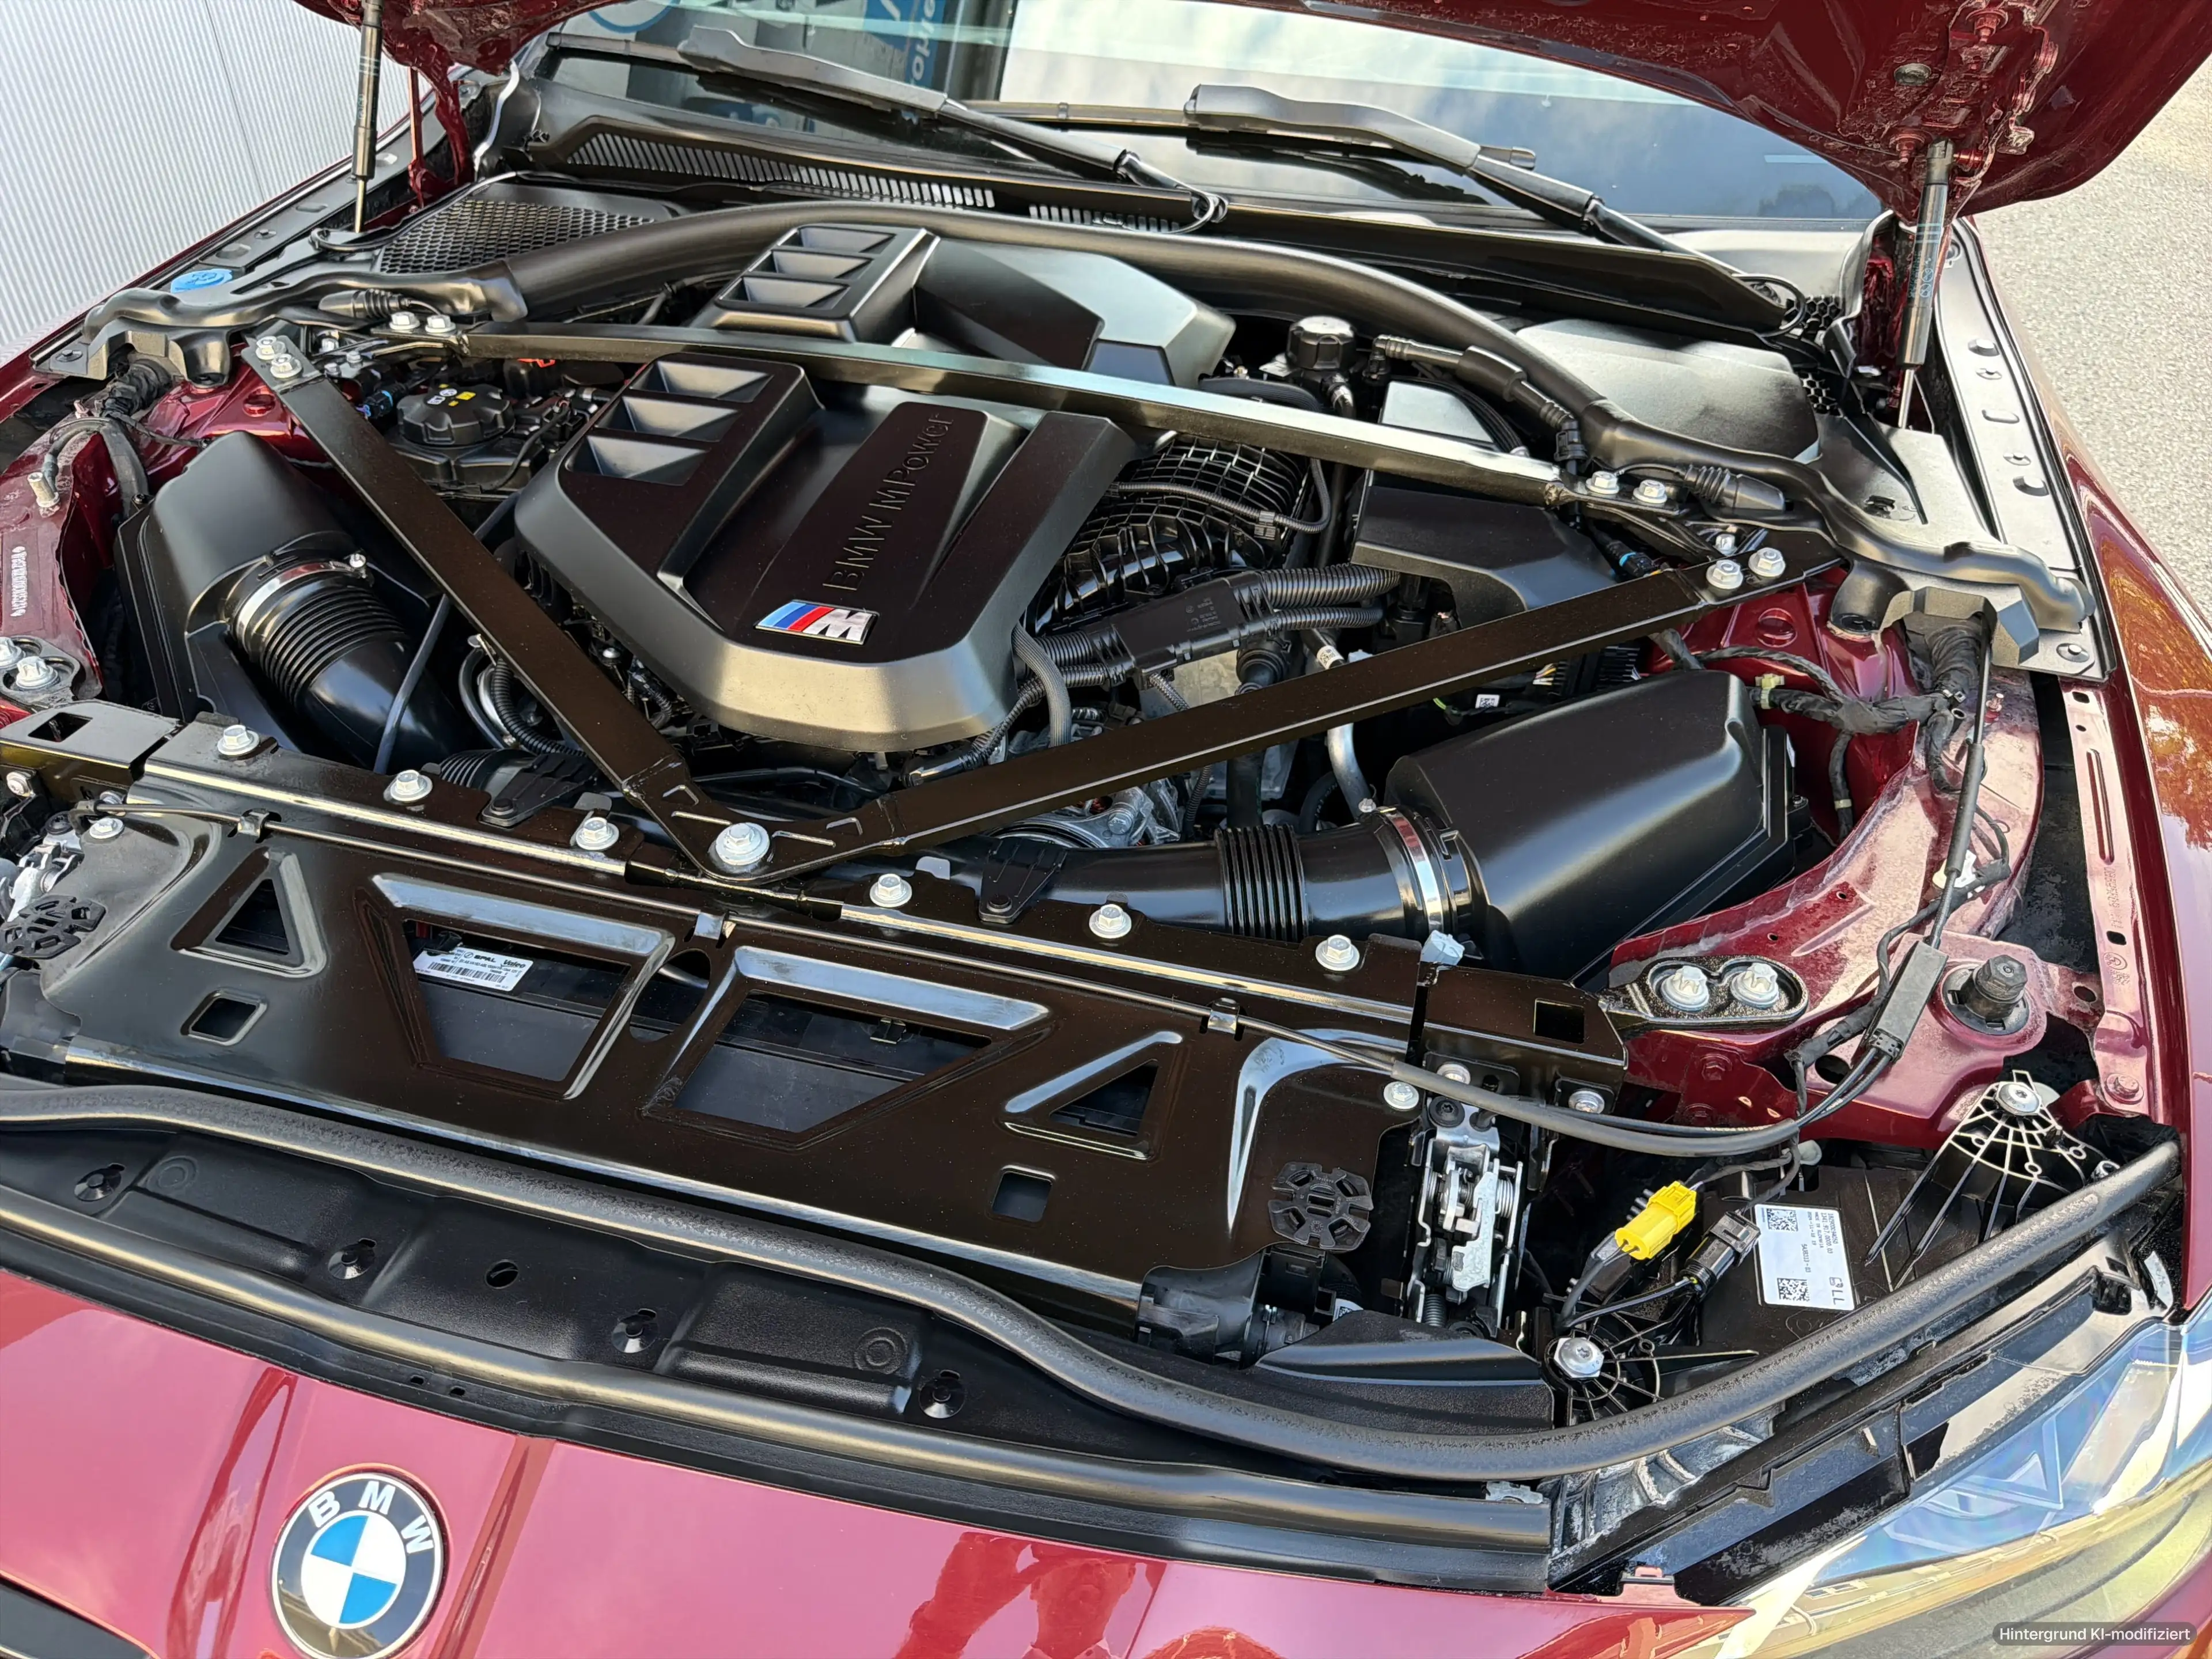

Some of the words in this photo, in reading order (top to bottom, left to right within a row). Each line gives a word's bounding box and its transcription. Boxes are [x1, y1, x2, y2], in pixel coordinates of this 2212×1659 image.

[823, 515, 892, 591] BMW
[501, 959, 526, 968] Valeo
[308, 1480, 434, 1554] BMW
